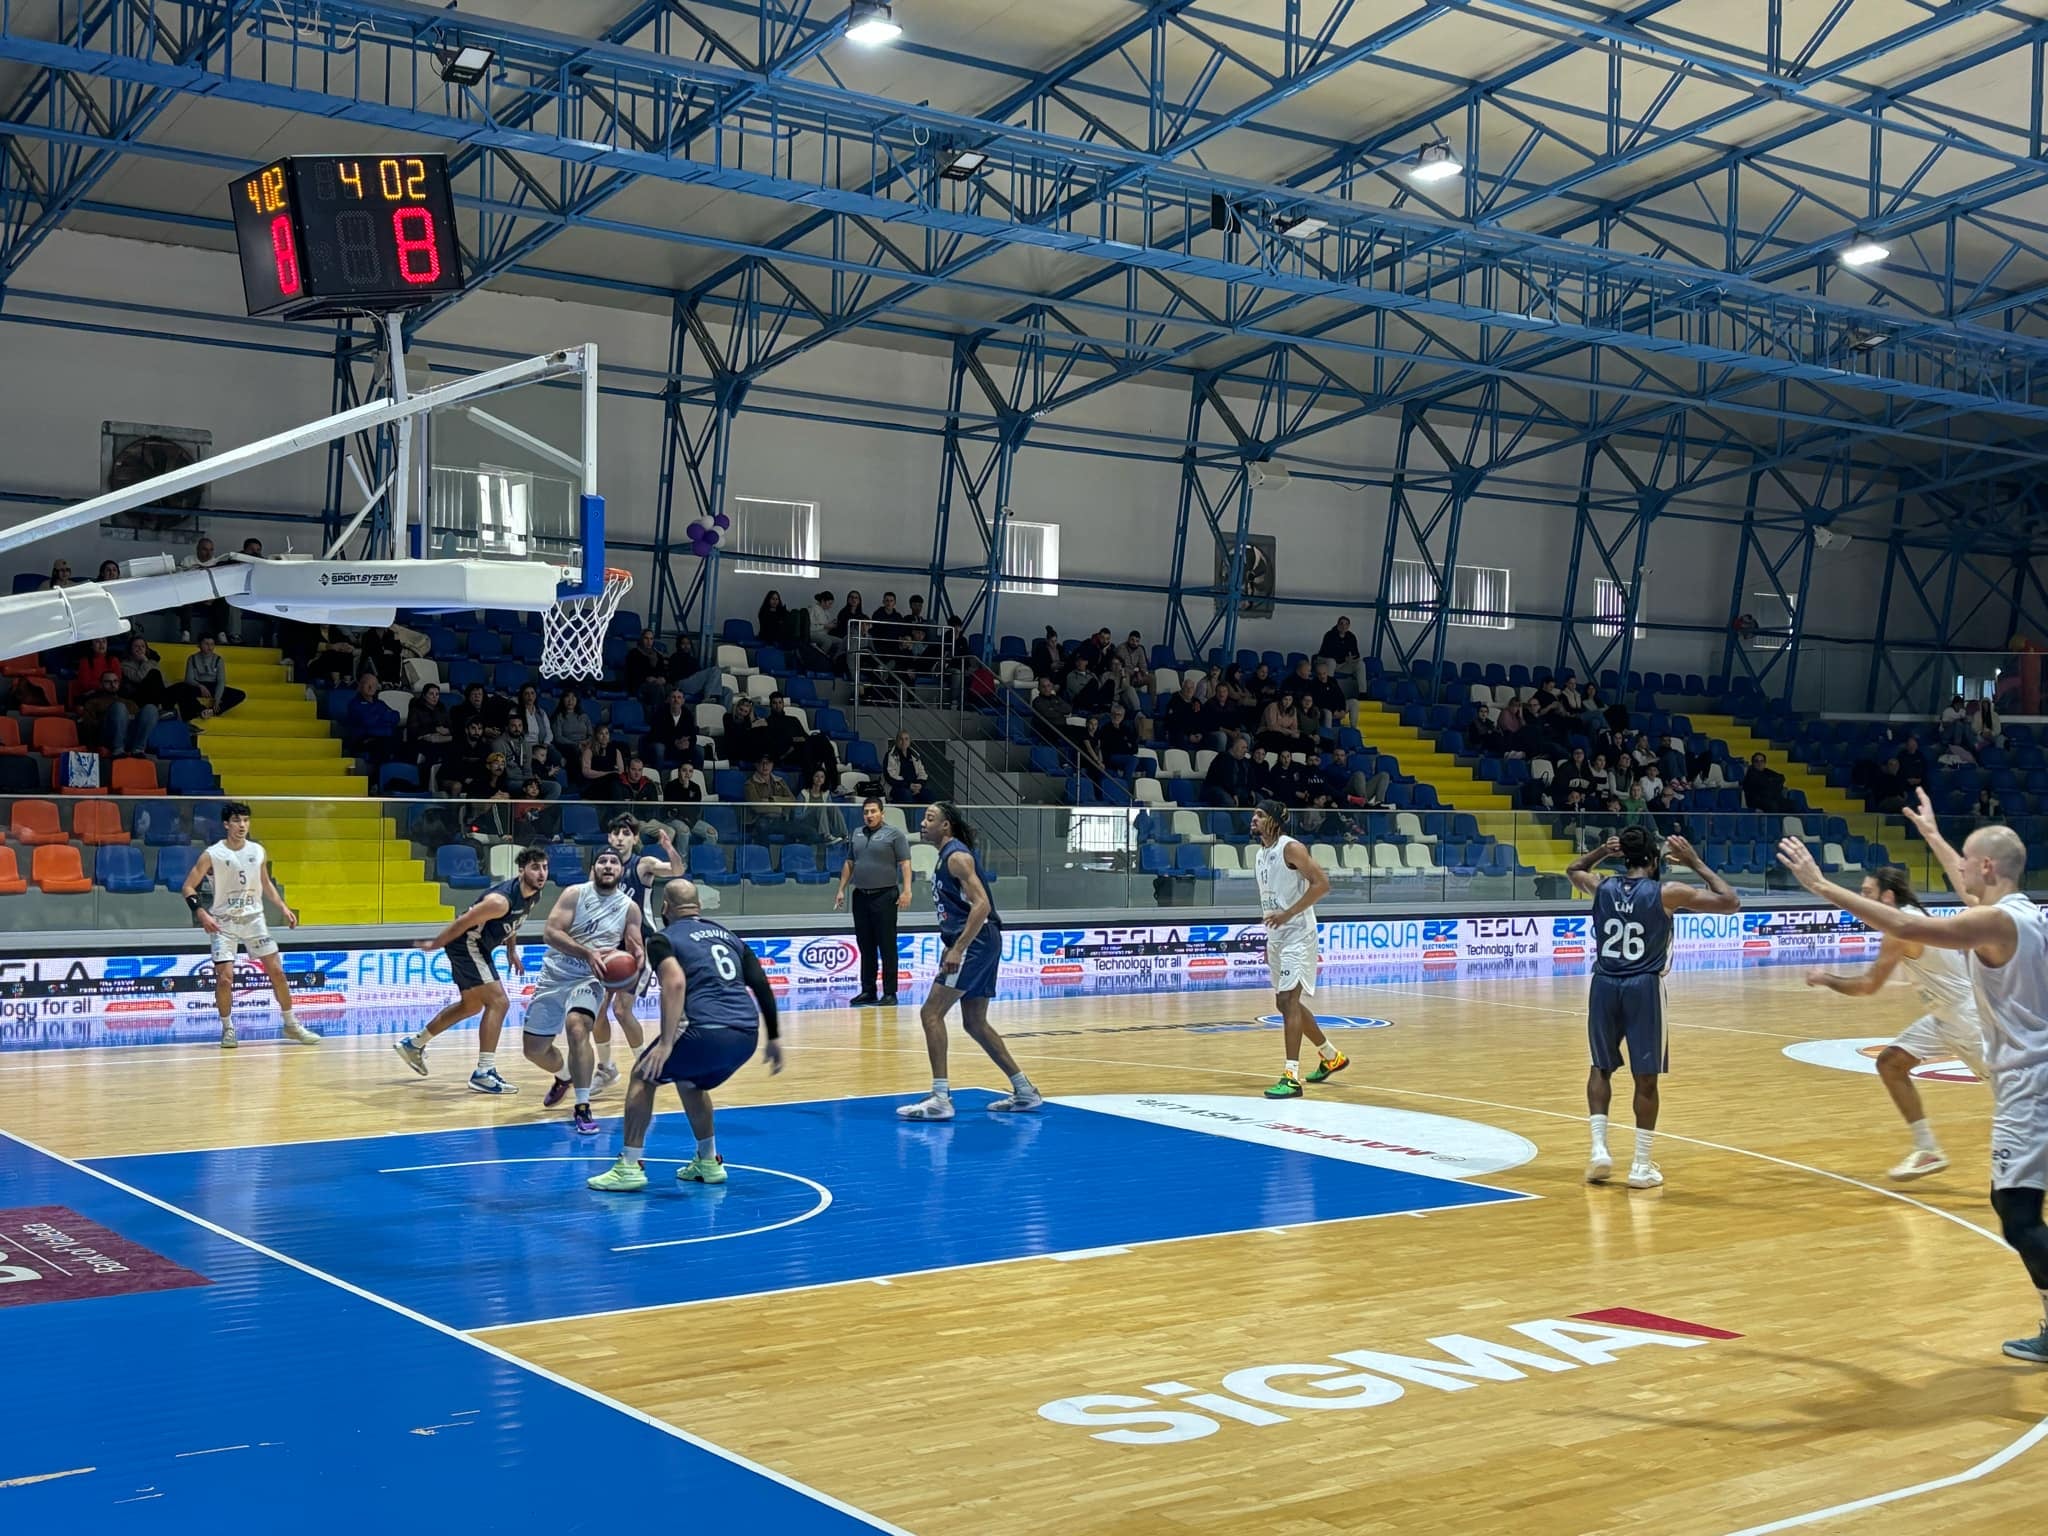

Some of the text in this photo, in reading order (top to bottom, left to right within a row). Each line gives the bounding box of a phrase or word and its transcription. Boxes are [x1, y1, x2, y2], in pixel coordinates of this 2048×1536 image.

[392, 207, 441, 285] 8
[239, 870, 247, 885] 5
[1329, 922, 1418, 950] FITAQUA
[1466, 918, 1539, 938] TESLA
[1467, 943, 1514, 957] Technology
[1515, 942, 1528, 954] for
[1529, 942, 1538, 953] all
[1601, 918, 1646, 961] 26
[1778, 934, 1816, 946] Technology
[1817, 933, 1827, 944] for
[711, 944, 737, 981] 6
[806, 946, 848, 970] argo
[1094, 958, 1152, 973] Technology
[1154, 956, 1170, 968] for
[1170, 956, 1182, 968] all
[798, 975, 858, 984] Climate Control
[42, 998, 69, 1015] for
[72, 997, 91, 1013] all
[1256, 1122, 1438, 1156] MAPFRE
